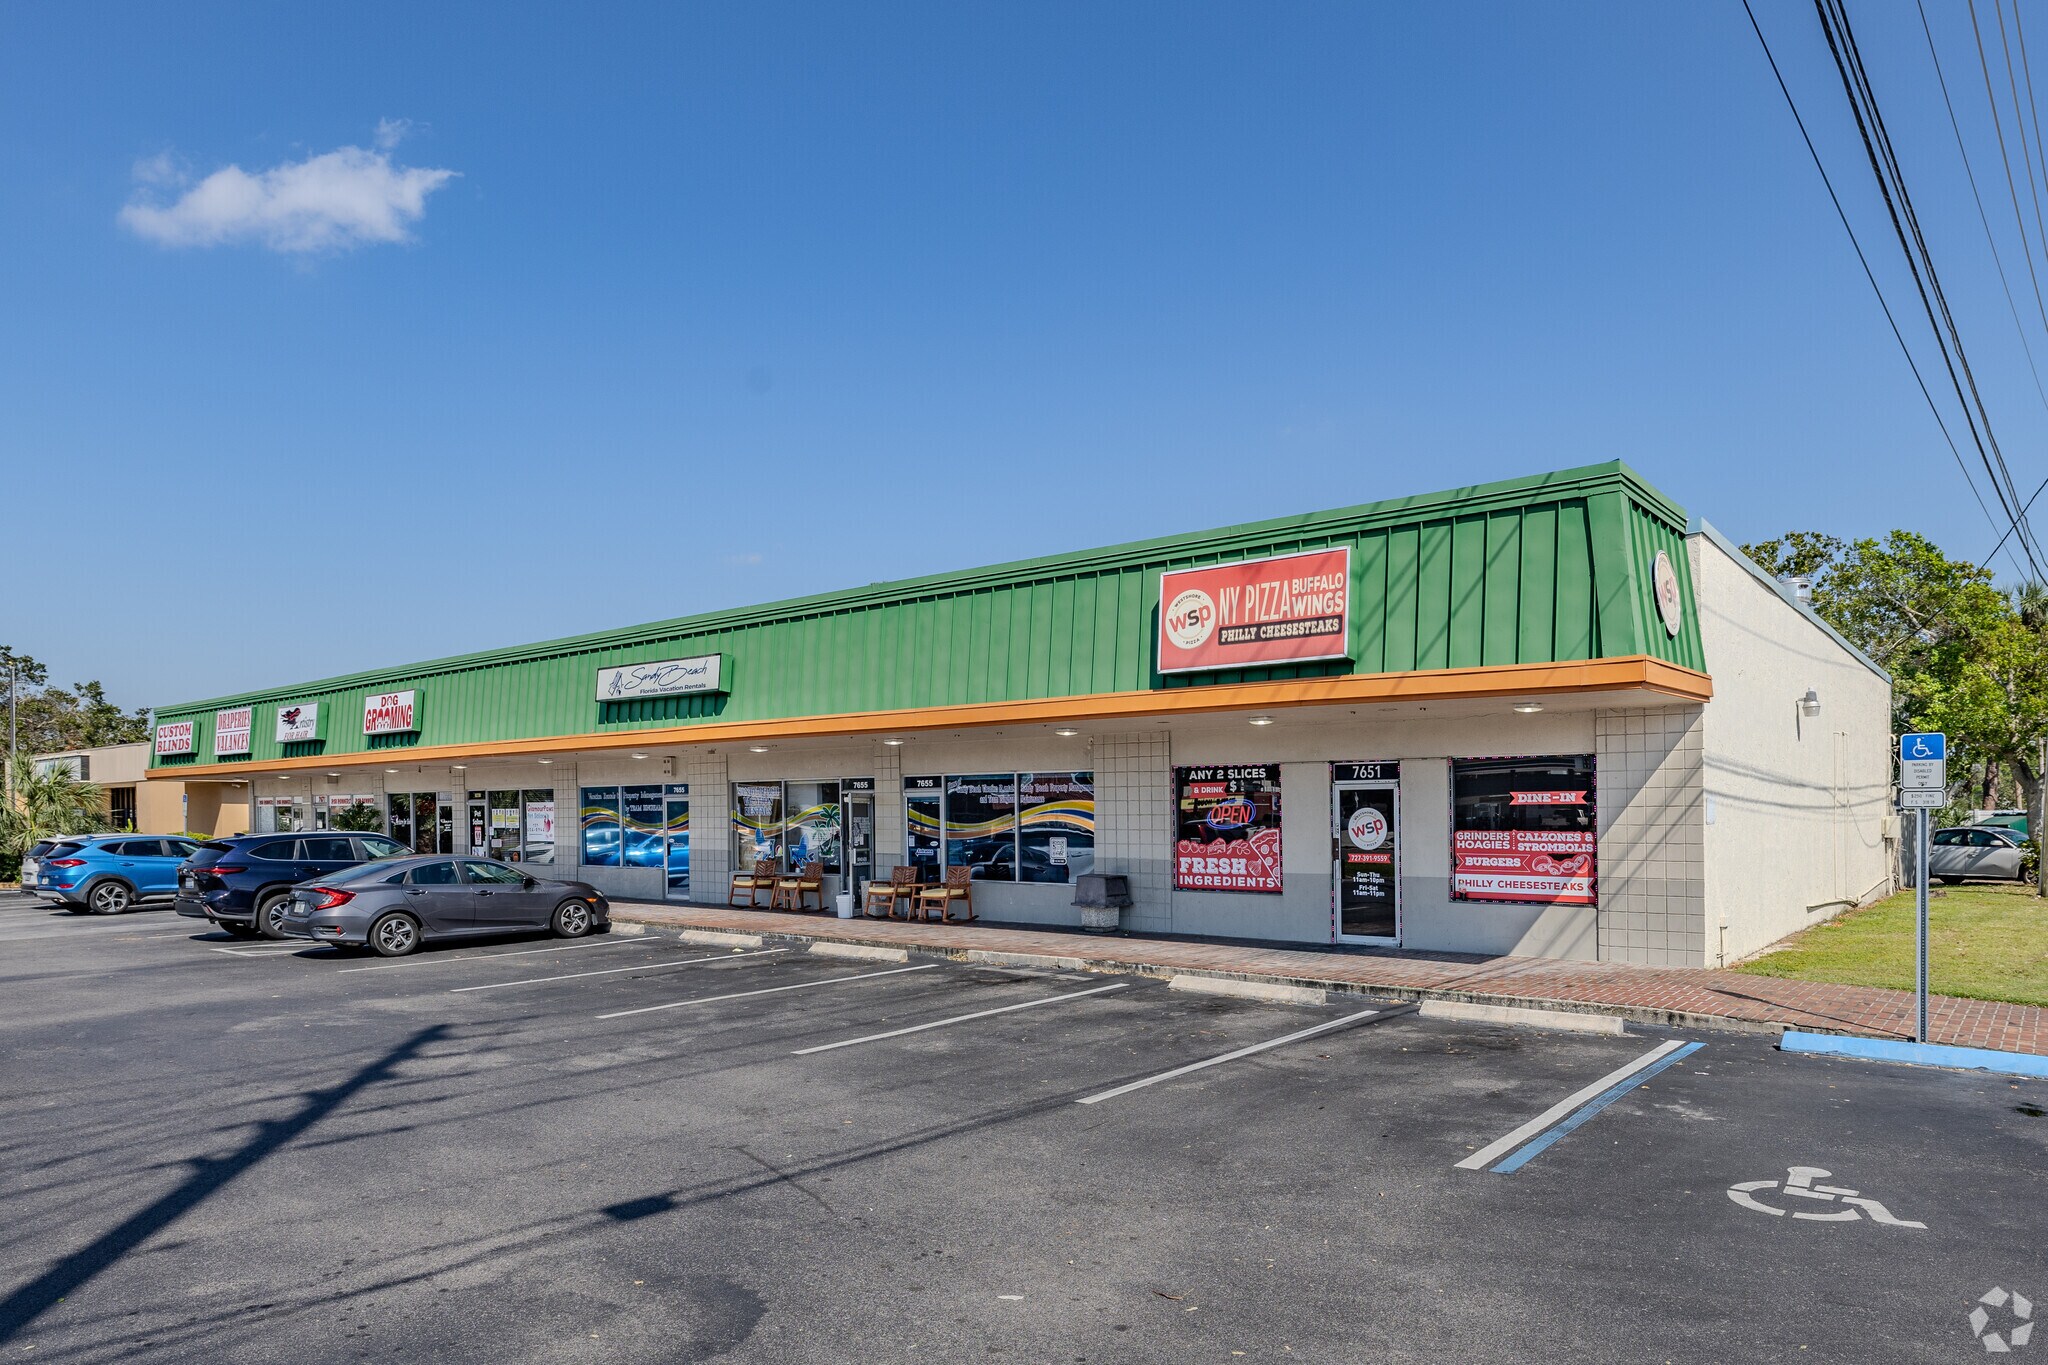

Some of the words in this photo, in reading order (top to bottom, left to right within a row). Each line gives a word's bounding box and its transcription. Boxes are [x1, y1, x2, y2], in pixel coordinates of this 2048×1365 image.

[1292, 572, 1344, 594] BUFFALO
[1174, 593, 1201, 607] WESTSHORE
[1219, 586, 1240, 626] NY
[1245, 580, 1291, 623] PIZZA
[1292, 590, 1344, 618] WINGS
[1221, 627, 1258, 642] PHILLY
[1260, 618, 1340, 640] CHEESESTEAKS
[624, 667, 661, 690] Sandy
[658, 660, 708, 686] Beach
[640, 687, 658, 695] Florida
[659, 685, 683, 693] Vacation
[381, 695, 398, 706] DOG
[218, 710, 251, 730] DRAPERIES
[365, 704, 412, 731] GROOMING
[158, 723, 192, 739] CUSTOM
[157, 738, 190, 752] BLINDS
[217, 733, 249, 751] VALANCES
[1189, 770, 1214, 780] ANY
[1216, 770, 1224, 779] 2
[1227, 768, 1266, 779] SLICES
[1352, 765, 1381, 779] 7651
[1211, 804, 1251, 824] OPEN
[1456, 832, 1510, 841] GRINDERS
[1517, 832, 1582, 842] CALZONES
[1584, 833, 1593, 842] &
[1457, 840, 1510, 849] HOAGIES
[1517, 842, 1594, 853] STROMBOLIS
[1179, 857, 1247, 875] FRESH
[1465, 856, 1521, 867] BURGERS
[1180, 875, 1275, 888] INGREDIENTS
[1458, 879, 1493, 888] PHILLY
[1498, 879, 1584, 891] CHEESESTEAKS
